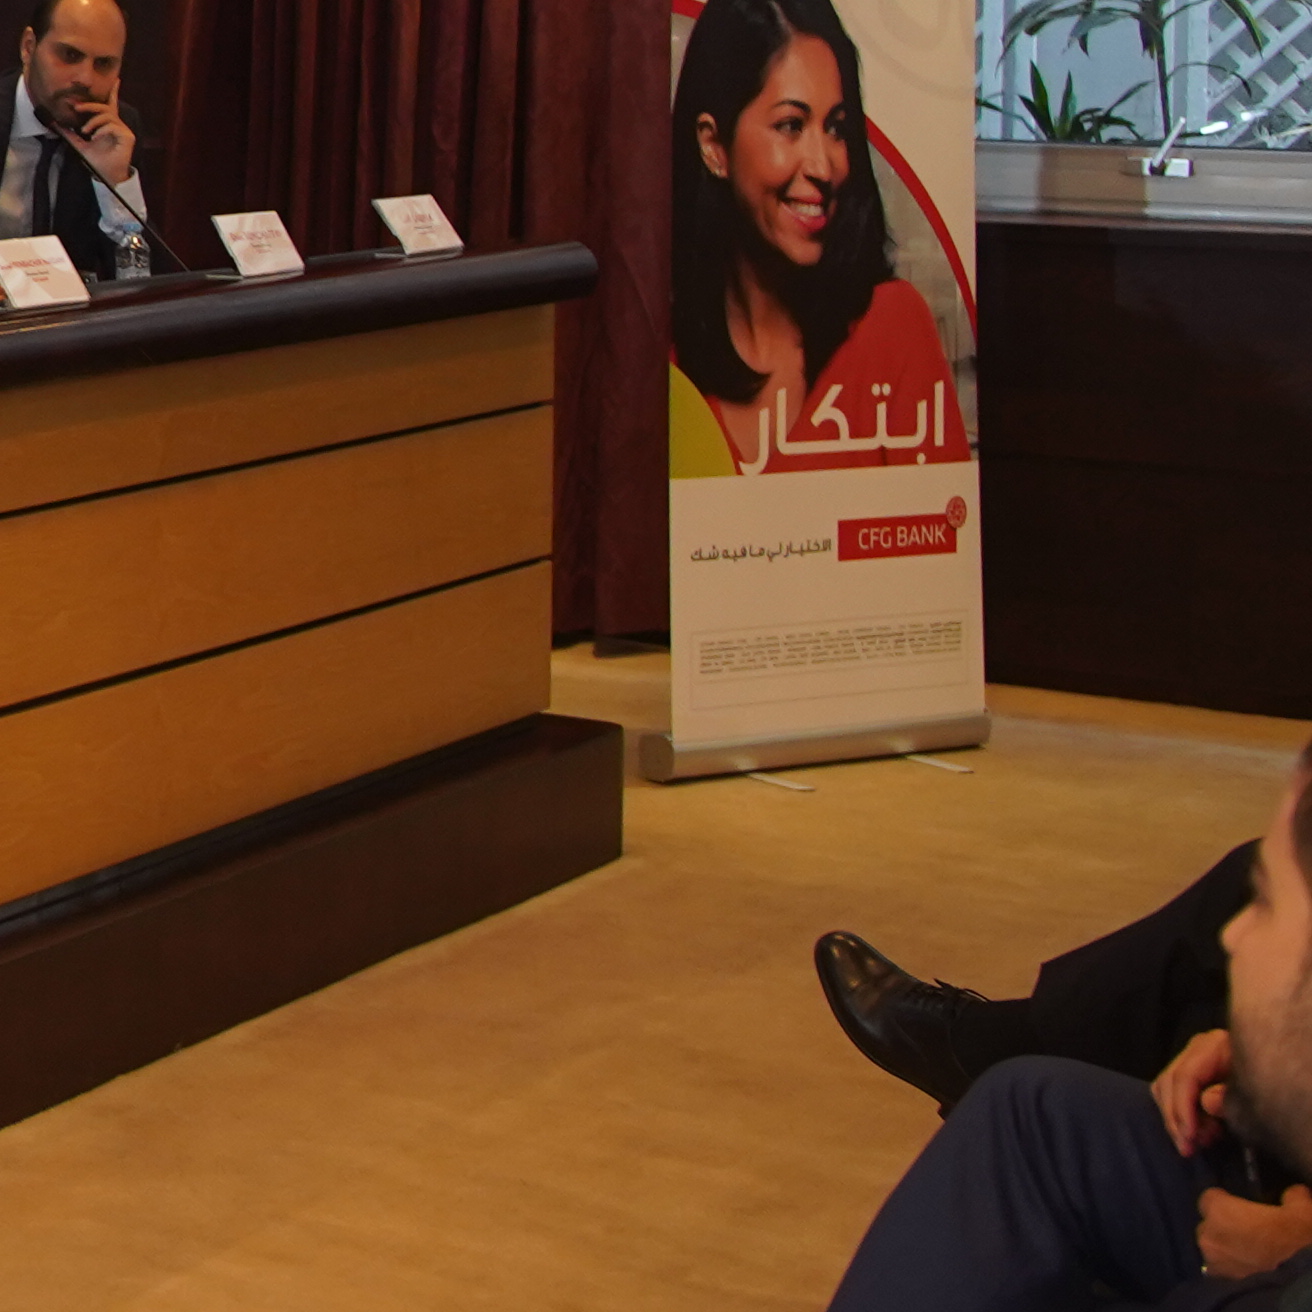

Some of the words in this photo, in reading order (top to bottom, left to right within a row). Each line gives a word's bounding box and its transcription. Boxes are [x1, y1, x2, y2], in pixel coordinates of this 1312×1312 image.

[738, 380, 945, 476] ابتكار
[858, 528, 891, 550] CFG
[897, 523, 947, 547] BANK
